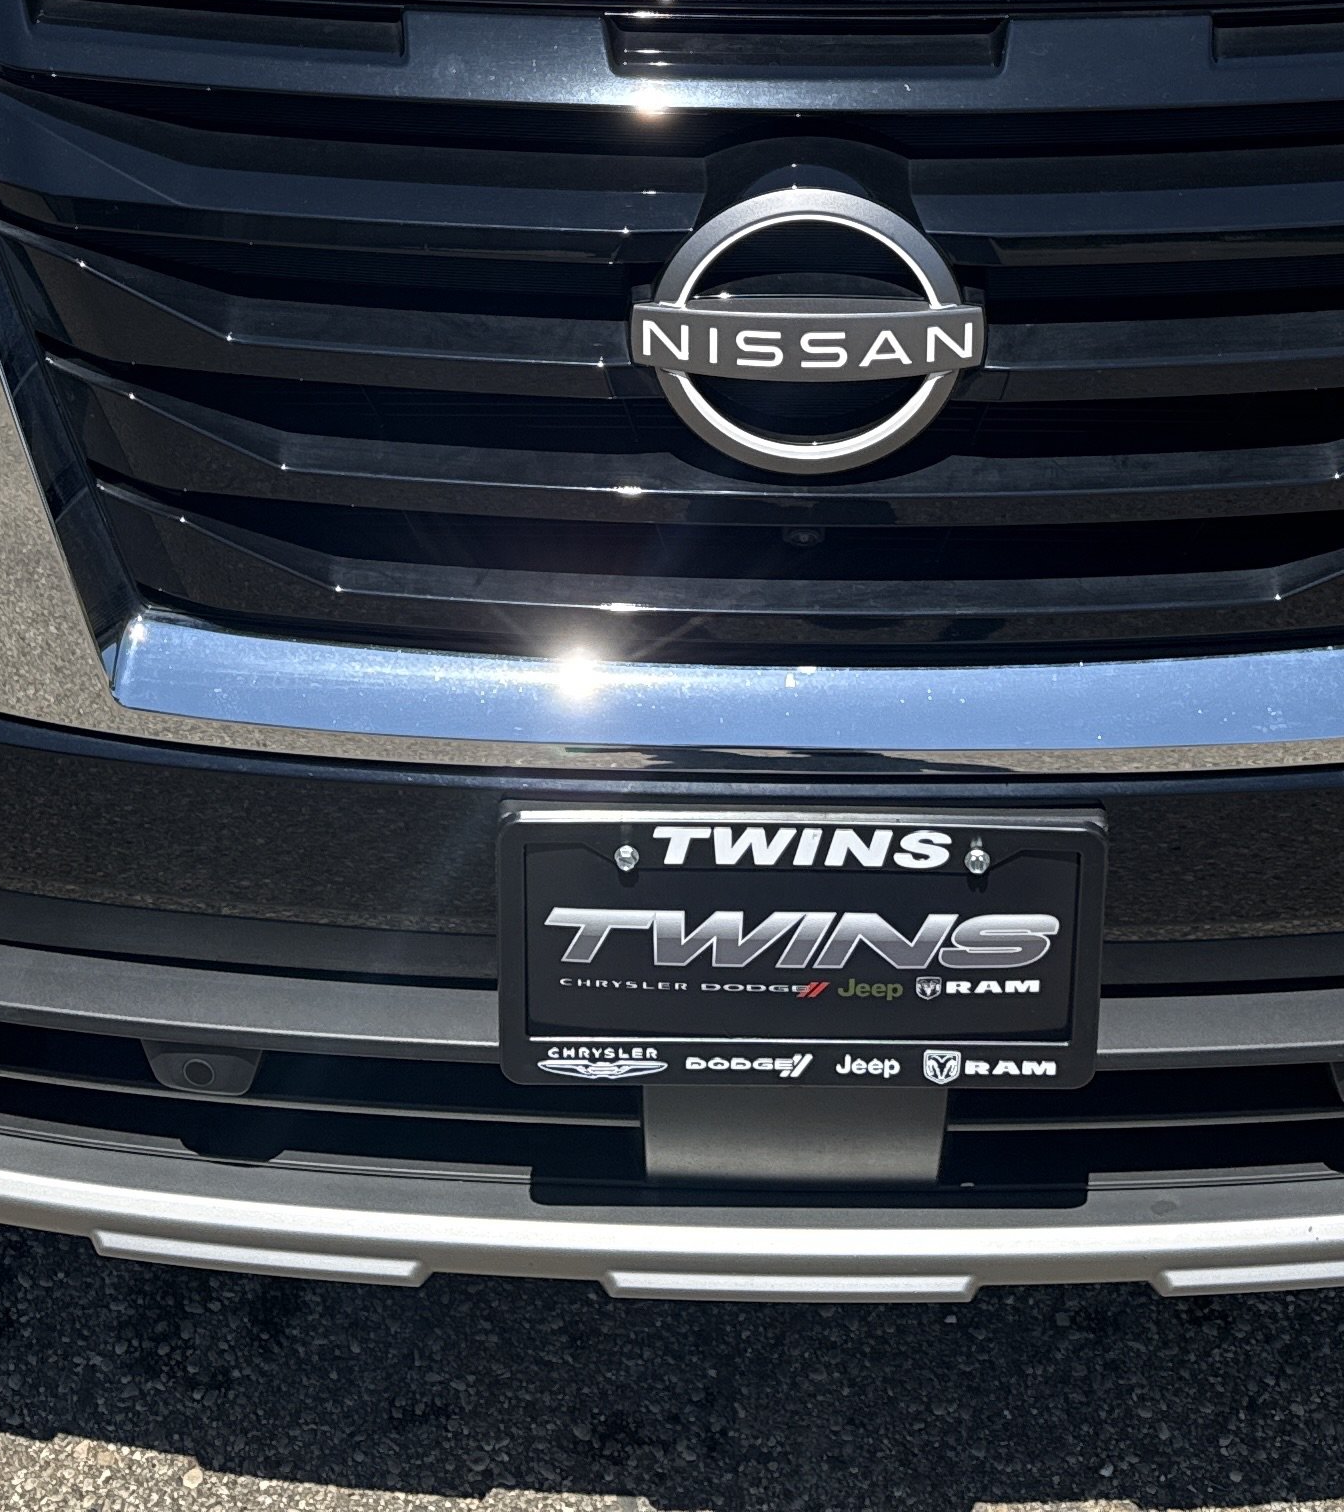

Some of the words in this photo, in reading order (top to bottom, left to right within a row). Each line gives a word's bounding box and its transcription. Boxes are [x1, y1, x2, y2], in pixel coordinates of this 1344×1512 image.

[642, 320, 973, 368] NISSAN
[652, 826, 953, 869] TWINS
[544, 906, 1060, 970] TWINS
[559, 977, 688, 991] CHRYSLER
[700, 983, 810, 994] DODGE
[837, 978, 904, 1000] Jeep
[945, 979, 1041, 994] RAM
[547, 1047, 659, 1059] CHRYSLER
[685, 1056, 796, 1071] DODGE
[835, 1054, 902, 1078] Jeep
[964, 1059, 1057, 1076] RAM
